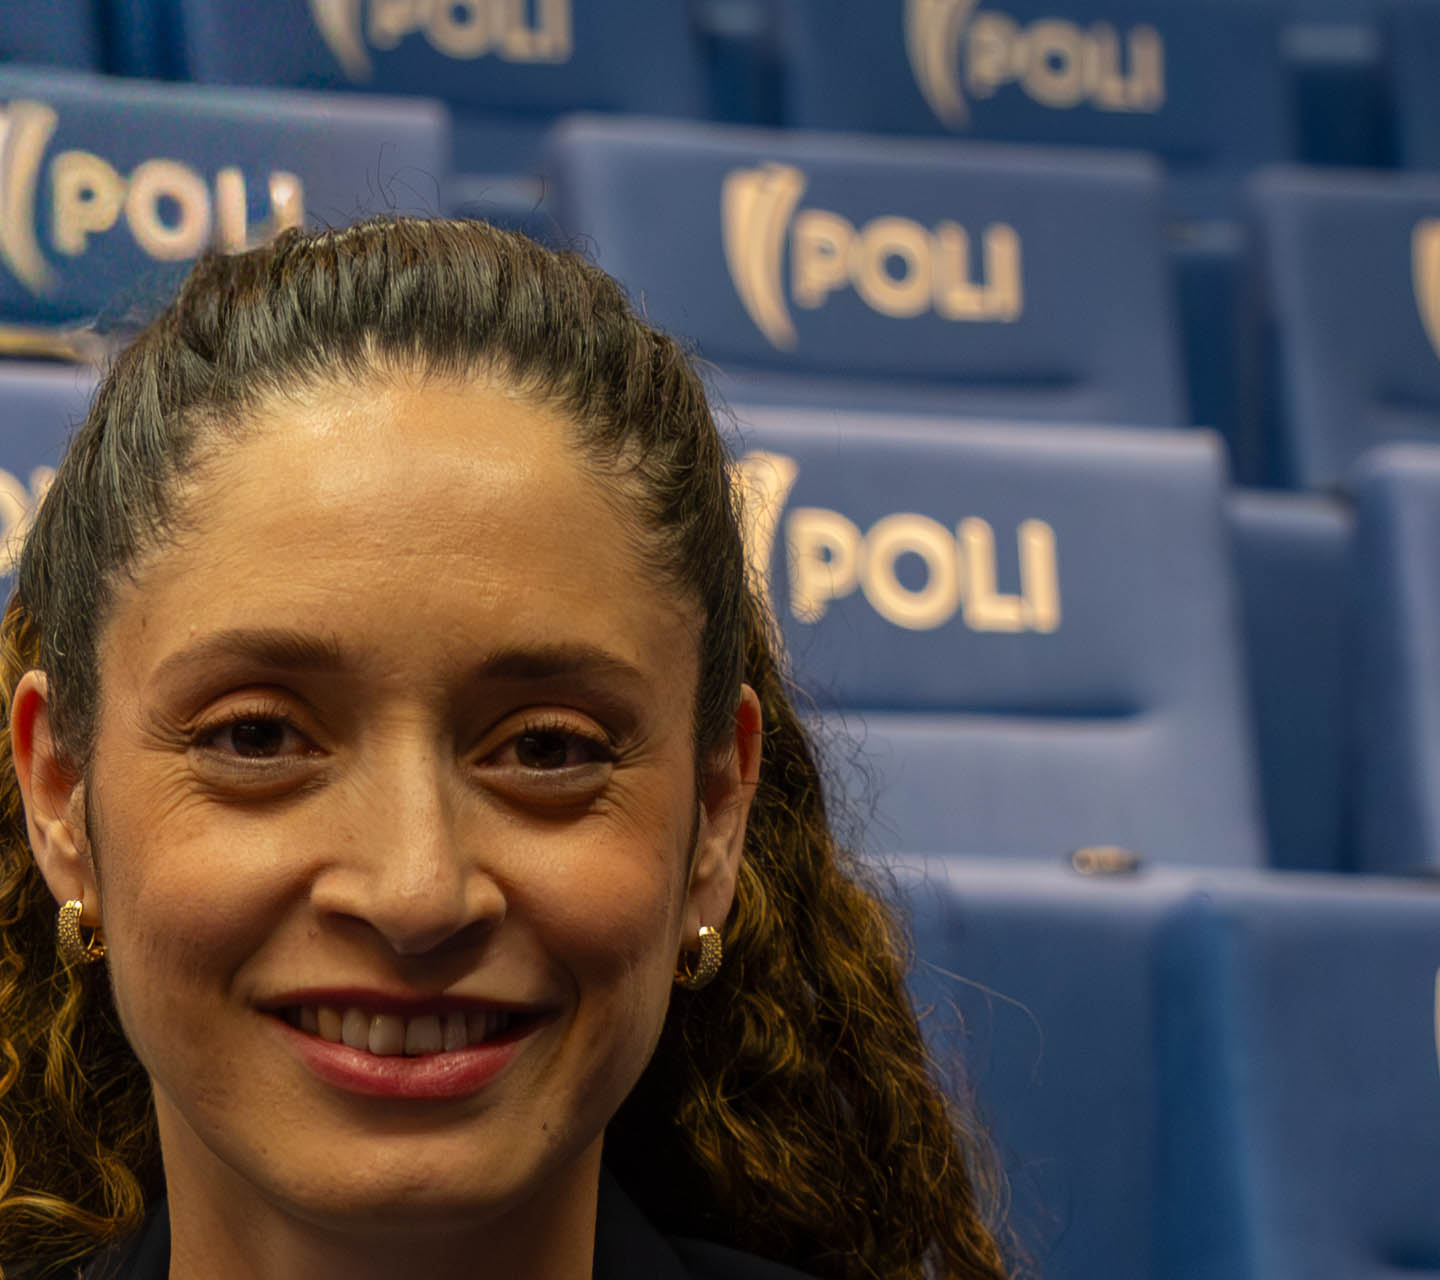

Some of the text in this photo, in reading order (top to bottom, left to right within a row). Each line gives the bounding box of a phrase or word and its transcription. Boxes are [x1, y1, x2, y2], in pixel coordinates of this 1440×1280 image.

[972, 12, 1165, 110] POLI
[792, 208, 1022, 320] POLI
[785, 507, 1061, 634] POLI
